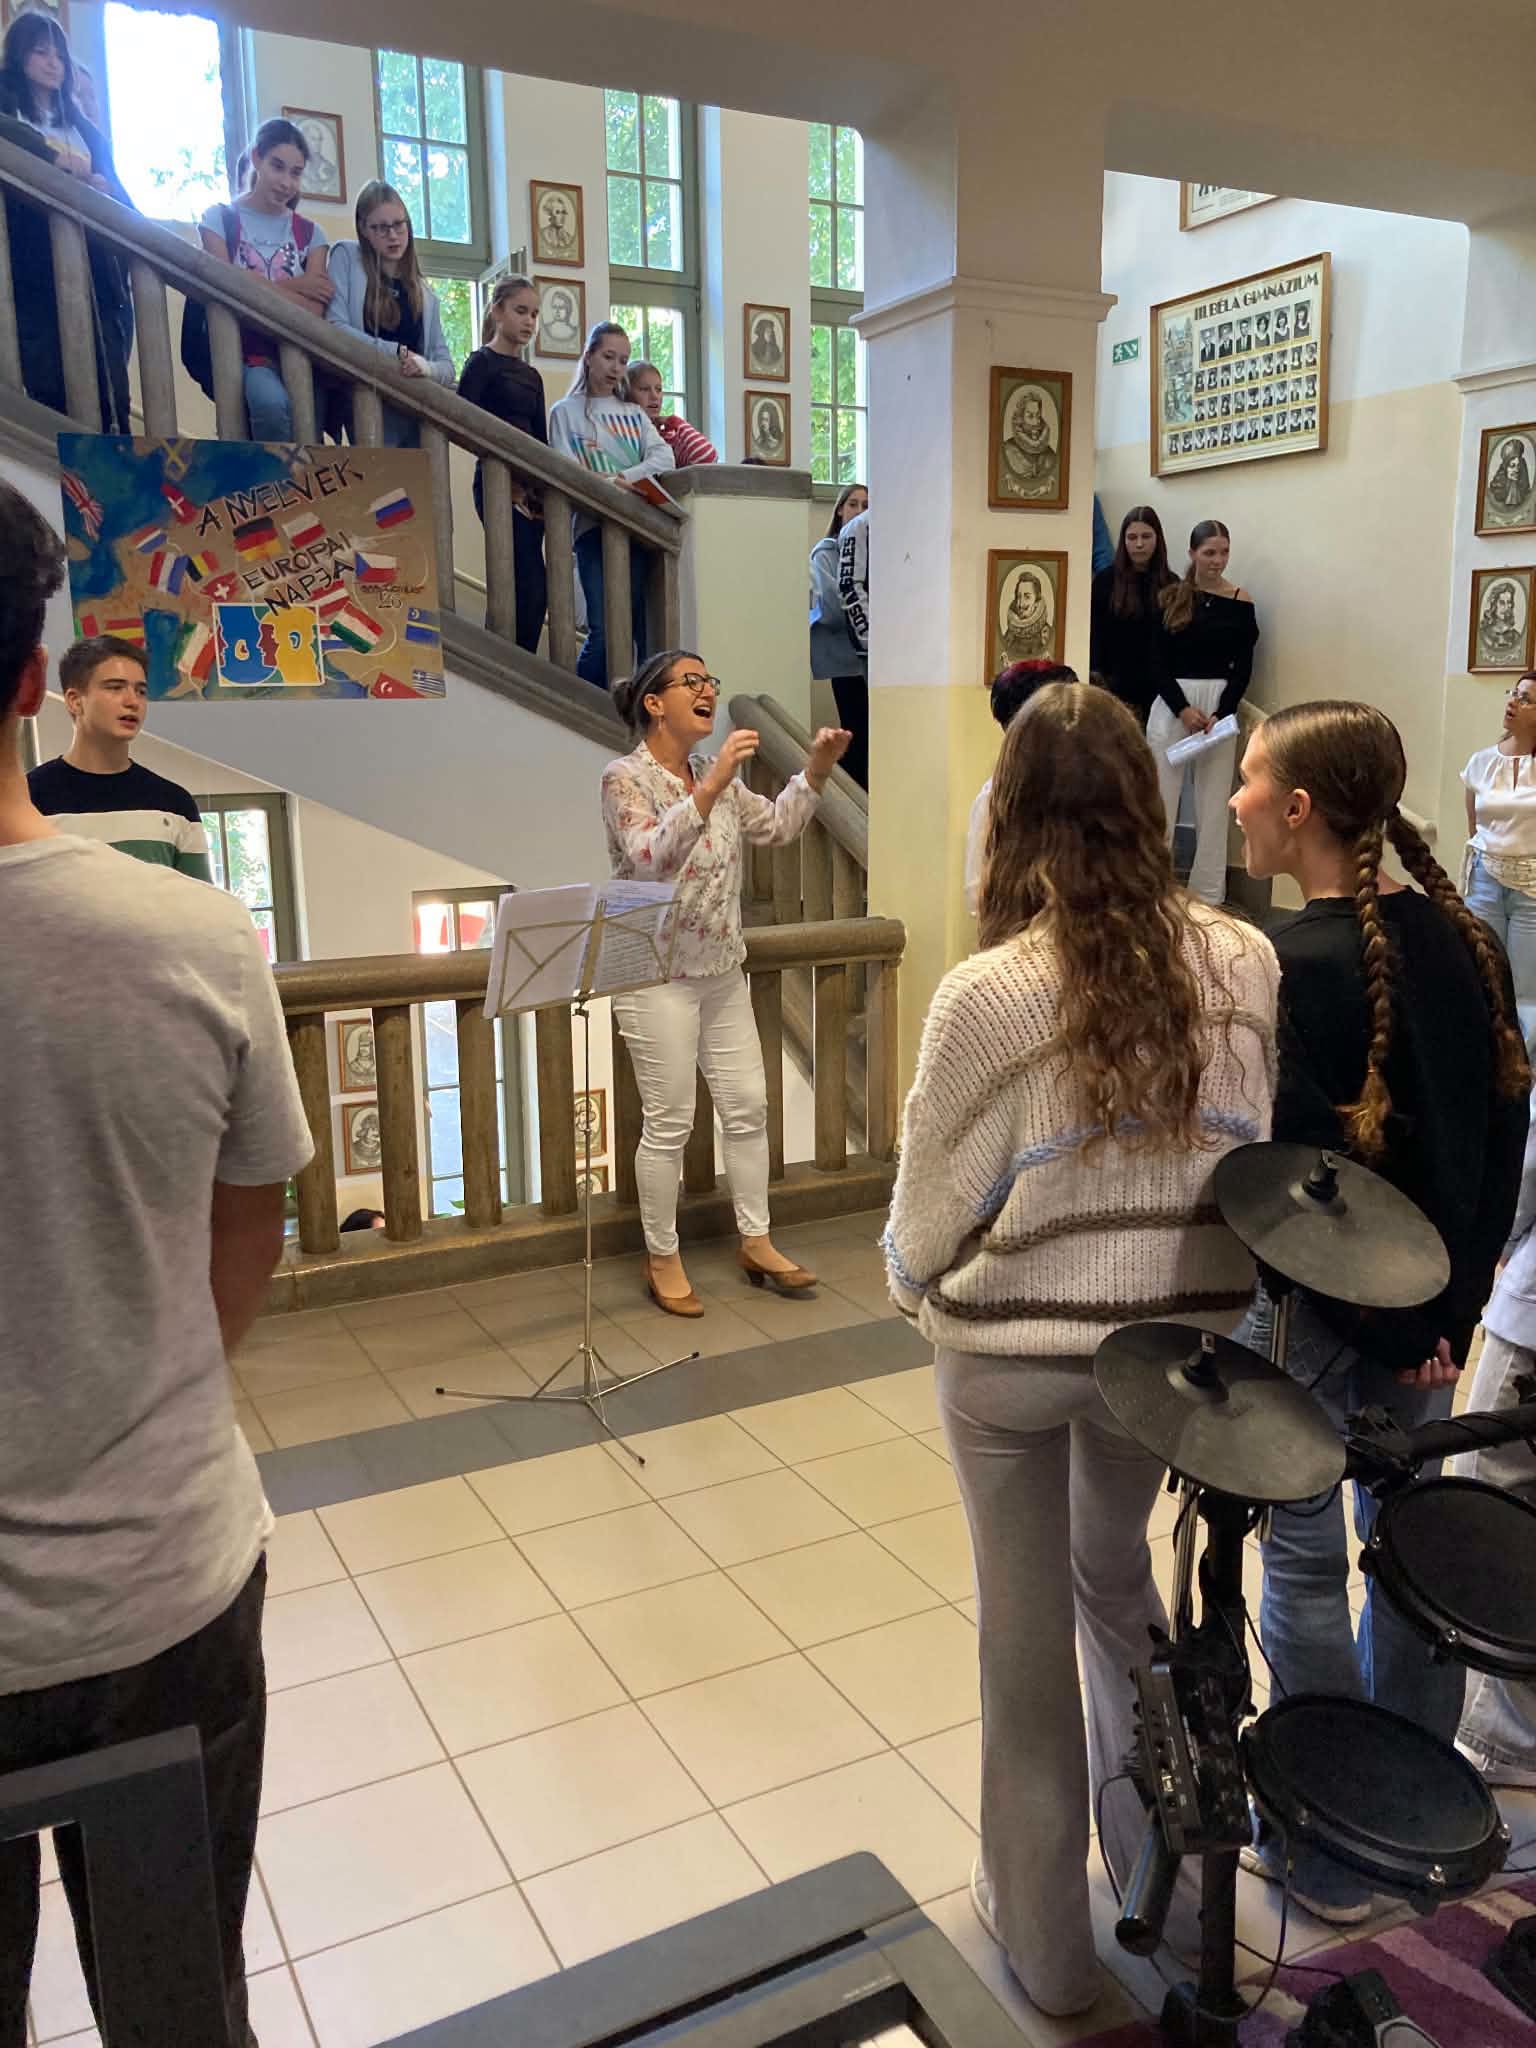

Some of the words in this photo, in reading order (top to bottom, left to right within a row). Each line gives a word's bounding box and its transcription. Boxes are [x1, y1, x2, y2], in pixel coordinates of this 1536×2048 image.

[1209, 295, 1240, 316] BÉLA
[1243, 271, 1319, 306] GIMNÁZIUM
[195, 507, 222, 537] A
[224, 457, 365, 522] NYELVEK
